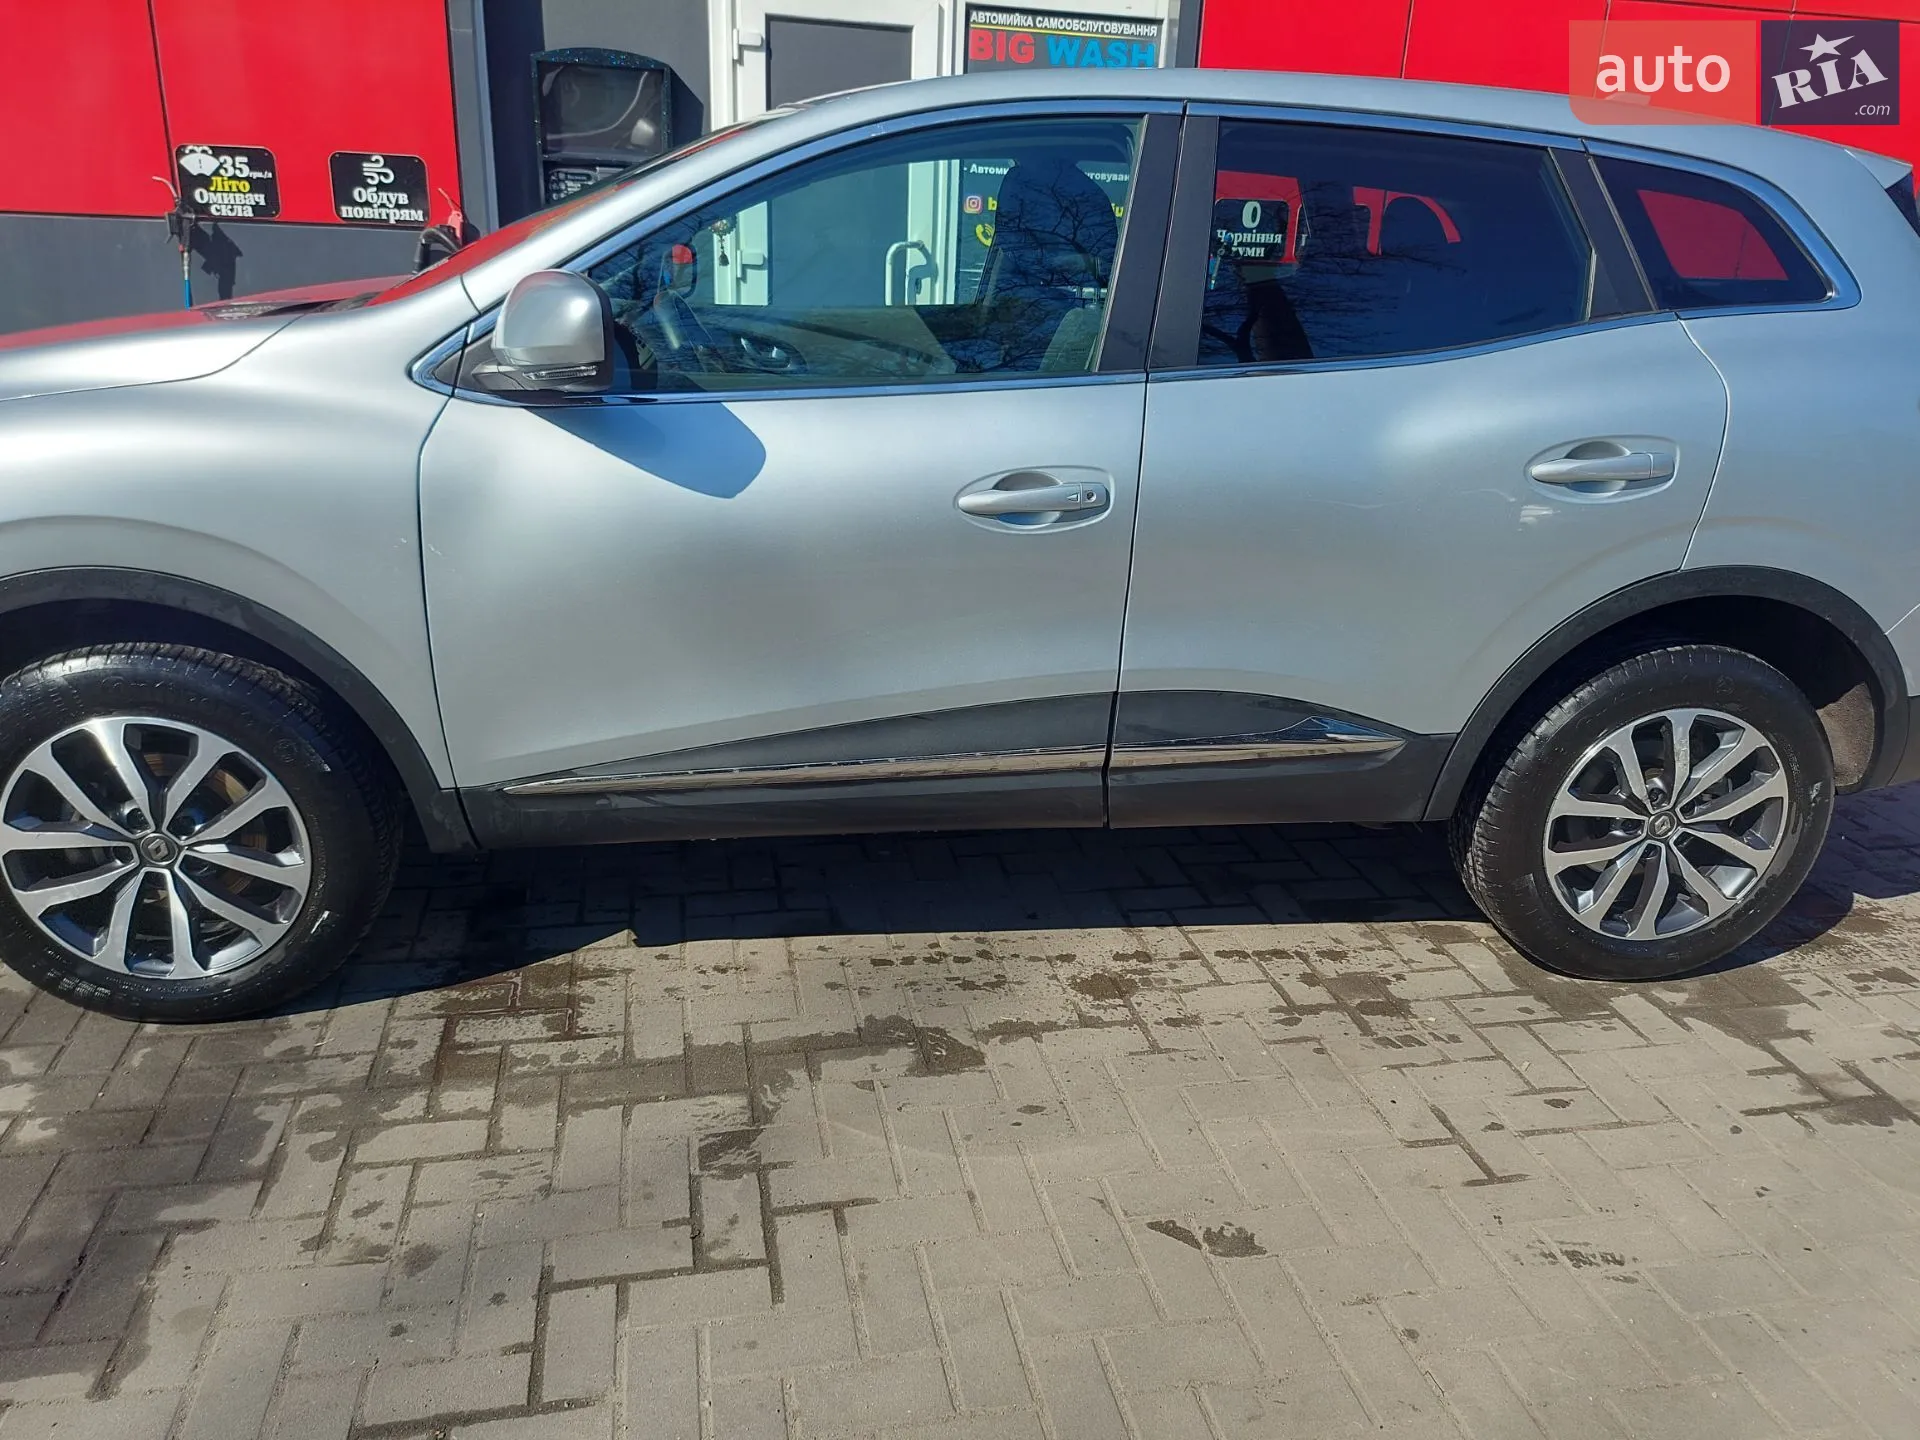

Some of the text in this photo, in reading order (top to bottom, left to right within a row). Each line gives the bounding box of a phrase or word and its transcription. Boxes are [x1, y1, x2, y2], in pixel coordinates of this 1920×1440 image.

[970, 11, 1158, 37] АВТОМИЙКА САМООБСЛУГОВУВАННЯ
[968, 28, 1156, 68] BIG WASH
[218, 155, 250, 178] 35
[970, 163, 1009, 175] Автоми
[209, 176, 251, 192] Літо
[194, 188, 266, 206] Омивач
[353, 186, 409, 208] Обдув
[210, 204, 254, 218] скла
[340, 205, 424, 224] повітрям
